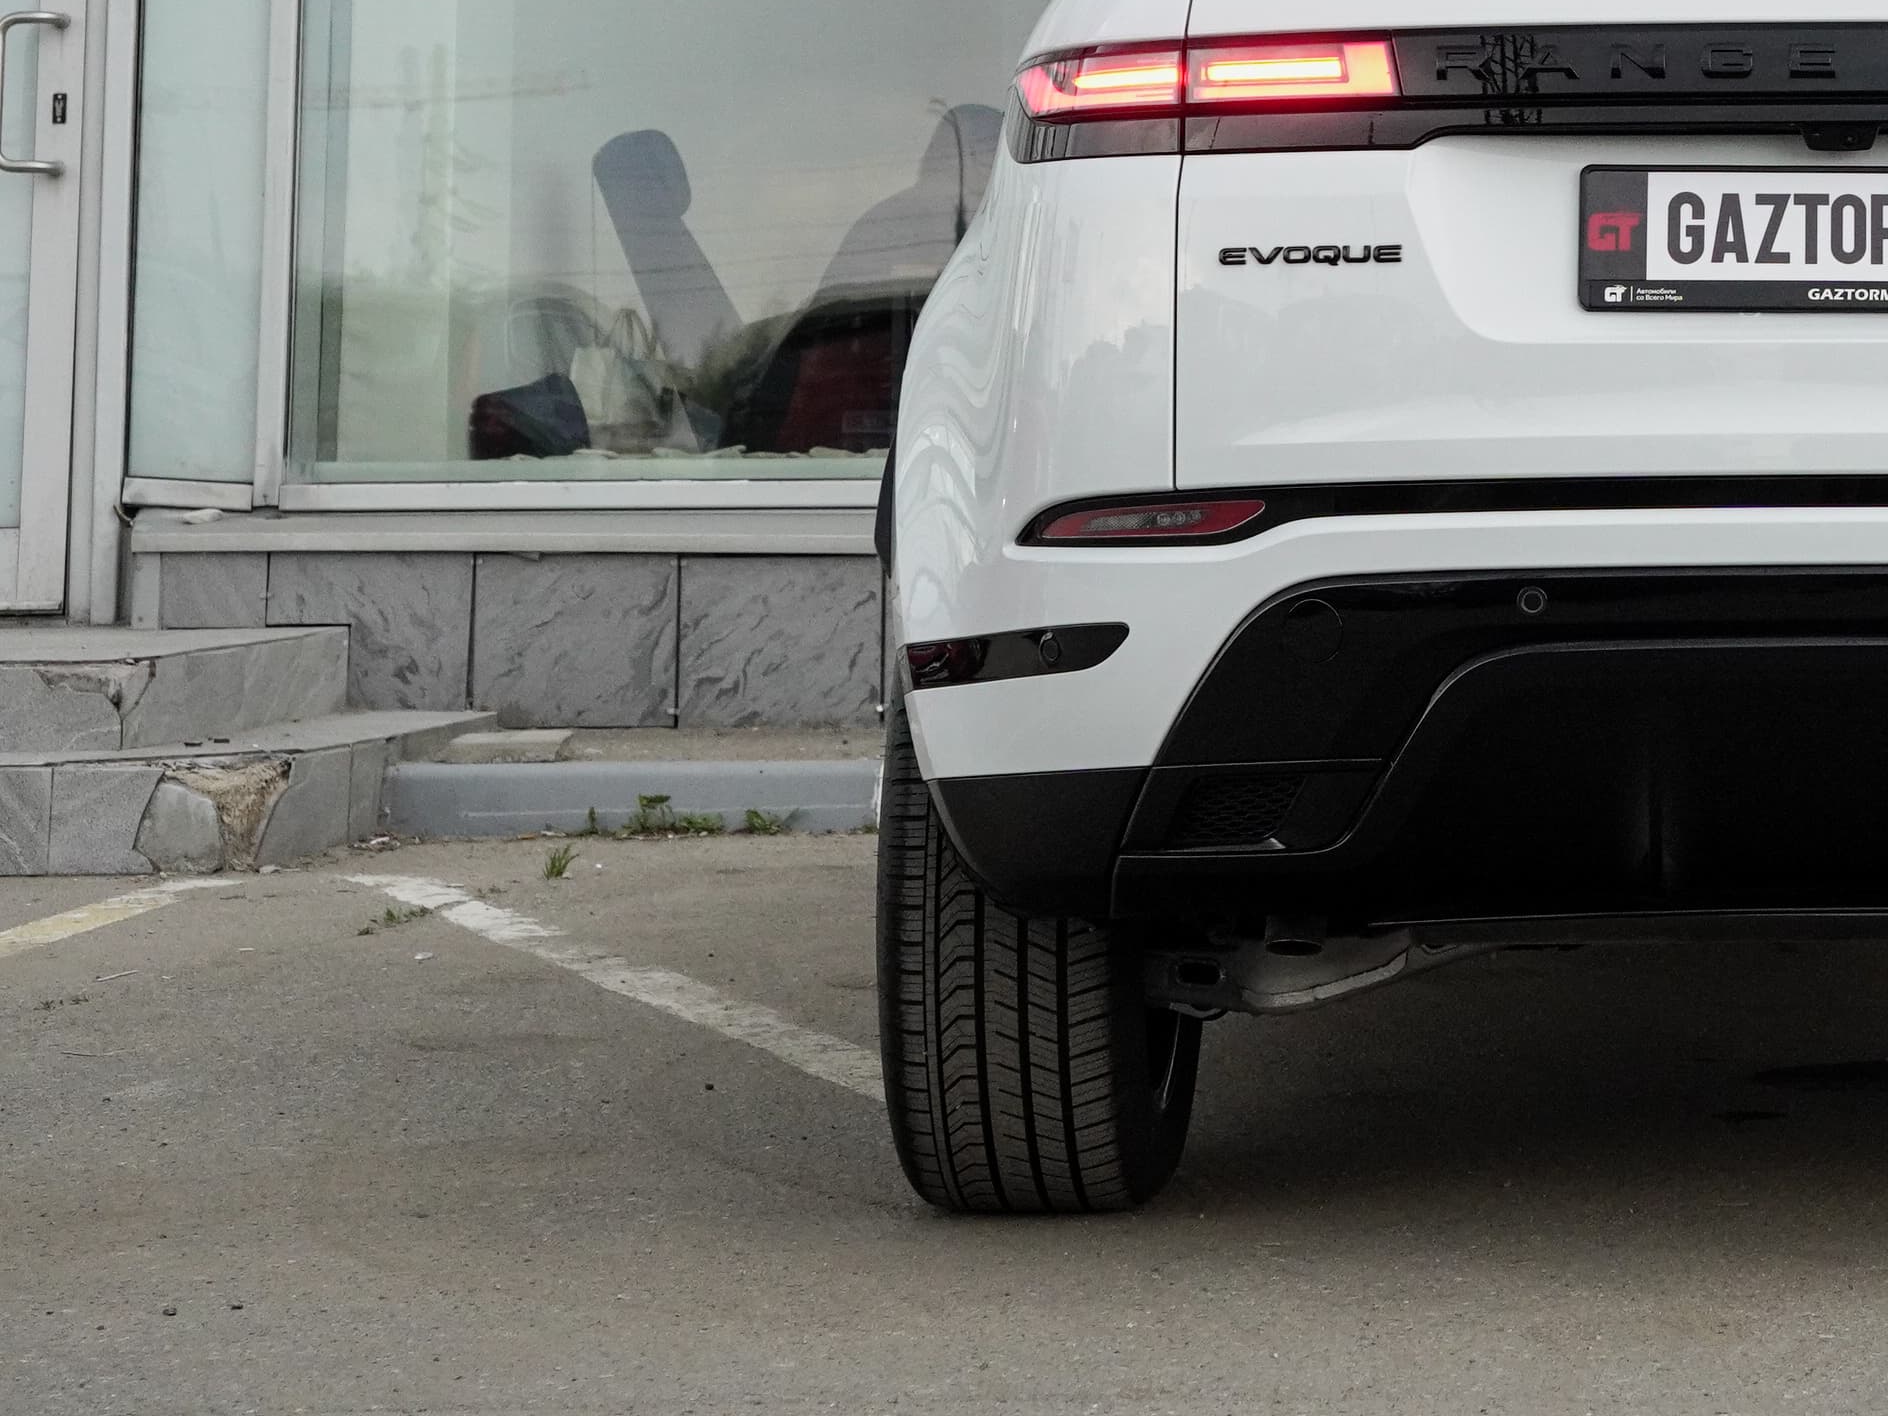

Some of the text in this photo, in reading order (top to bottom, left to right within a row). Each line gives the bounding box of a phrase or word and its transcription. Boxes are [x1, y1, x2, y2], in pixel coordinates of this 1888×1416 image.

[1435, 42, 1838, 81] RANGE
[1587, 211, 1640, 252] GT
[1218, 244, 1402, 266] EVOQUE
